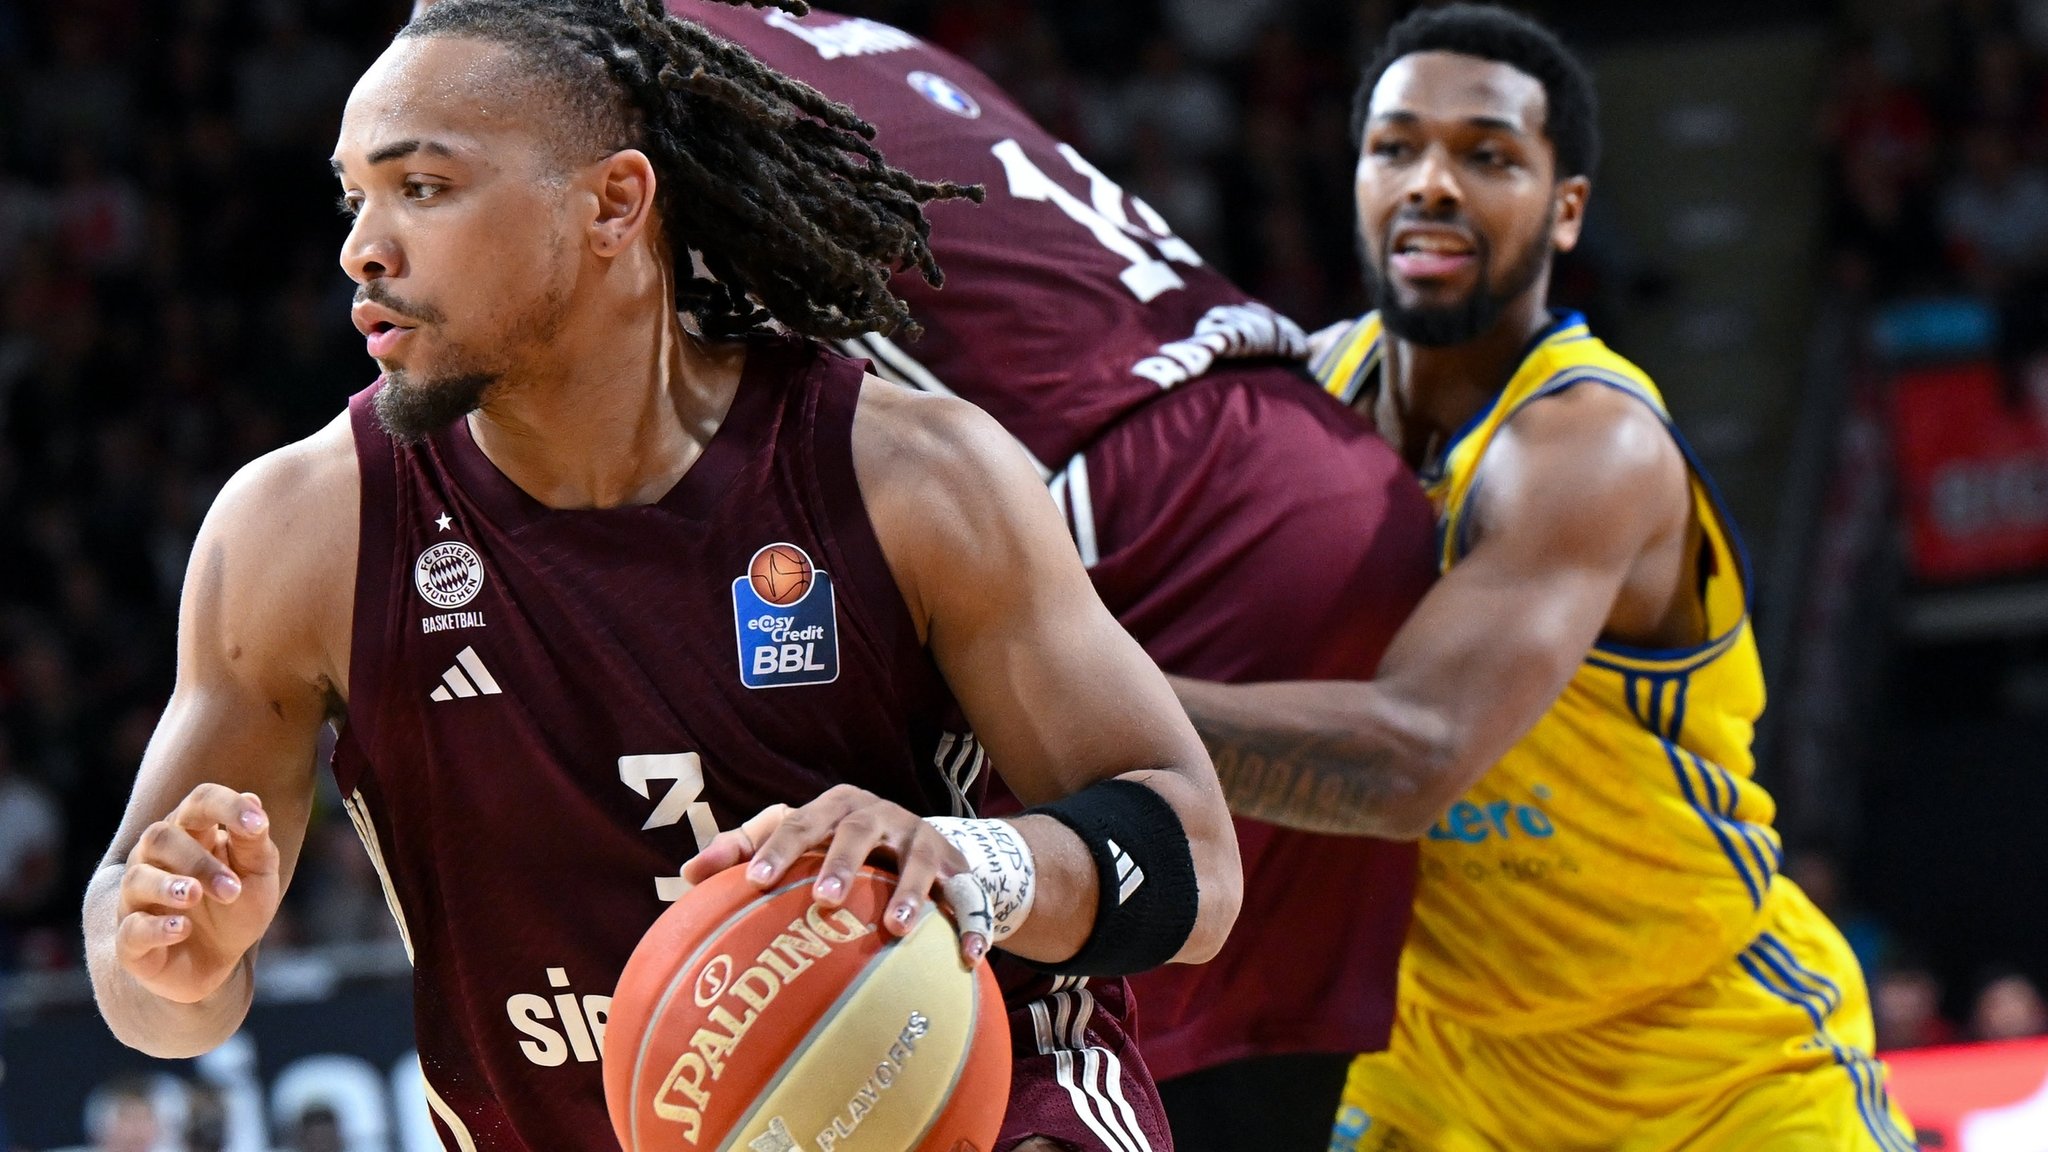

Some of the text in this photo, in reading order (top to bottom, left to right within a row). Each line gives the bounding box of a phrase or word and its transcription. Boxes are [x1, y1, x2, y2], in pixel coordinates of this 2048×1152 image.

[420, 546, 477, 571] FC BAYERN
[421, 611, 487, 634] BASKETBALL
[771, 625, 824, 643] Credit
[752, 642, 826, 676] BBL
[618, 751, 720, 902] 3
[653, 901, 870, 1146] SPALDING
[815, 1009, 929, 1152] PLAYOFFS
